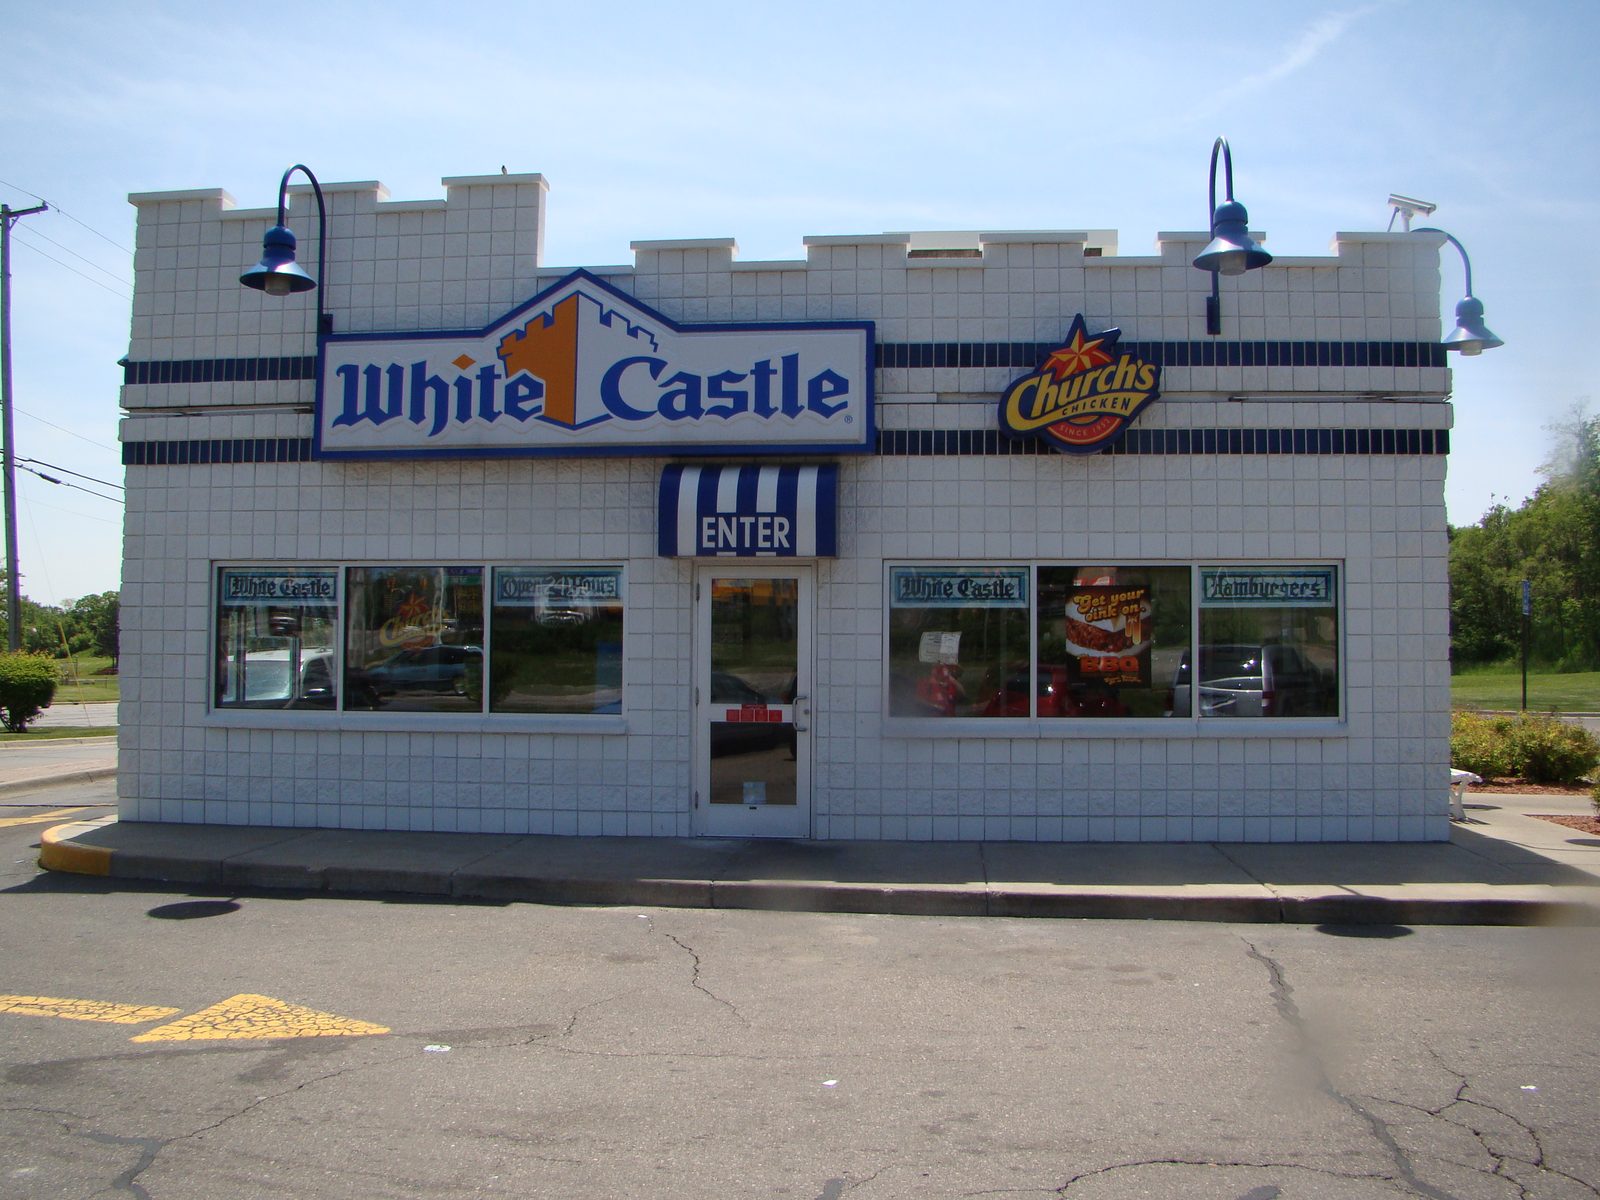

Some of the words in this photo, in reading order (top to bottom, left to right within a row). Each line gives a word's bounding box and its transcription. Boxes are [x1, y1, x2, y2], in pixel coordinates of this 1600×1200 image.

[332, 353, 545, 437] White
[600, 352, 850, 420] Castle
[1006, 354, 1156, 431] Church's
[1062, 397, 1131, 415] CHICKEN
[1059, 425, 1089, 437] SINCE
[702, 516, 790, 549] ENTER
[231, 576, 276, 599] White
[279, 577, 330, 597] Castle
[503, 576, 543, 599] Open
[567, 576, 617, 597] Hours
[900, 575, 954, 600] White
[957, 576, 1015, 598] Castle
[1210, 576, 1321, 601] Hamburgers
[1073, 594, 1106, 613] Get
[1110, 589, 1145, 605] your
[1085, 604, 1118, 622] oink
[1080, 656, 1139, 672] BBQ
